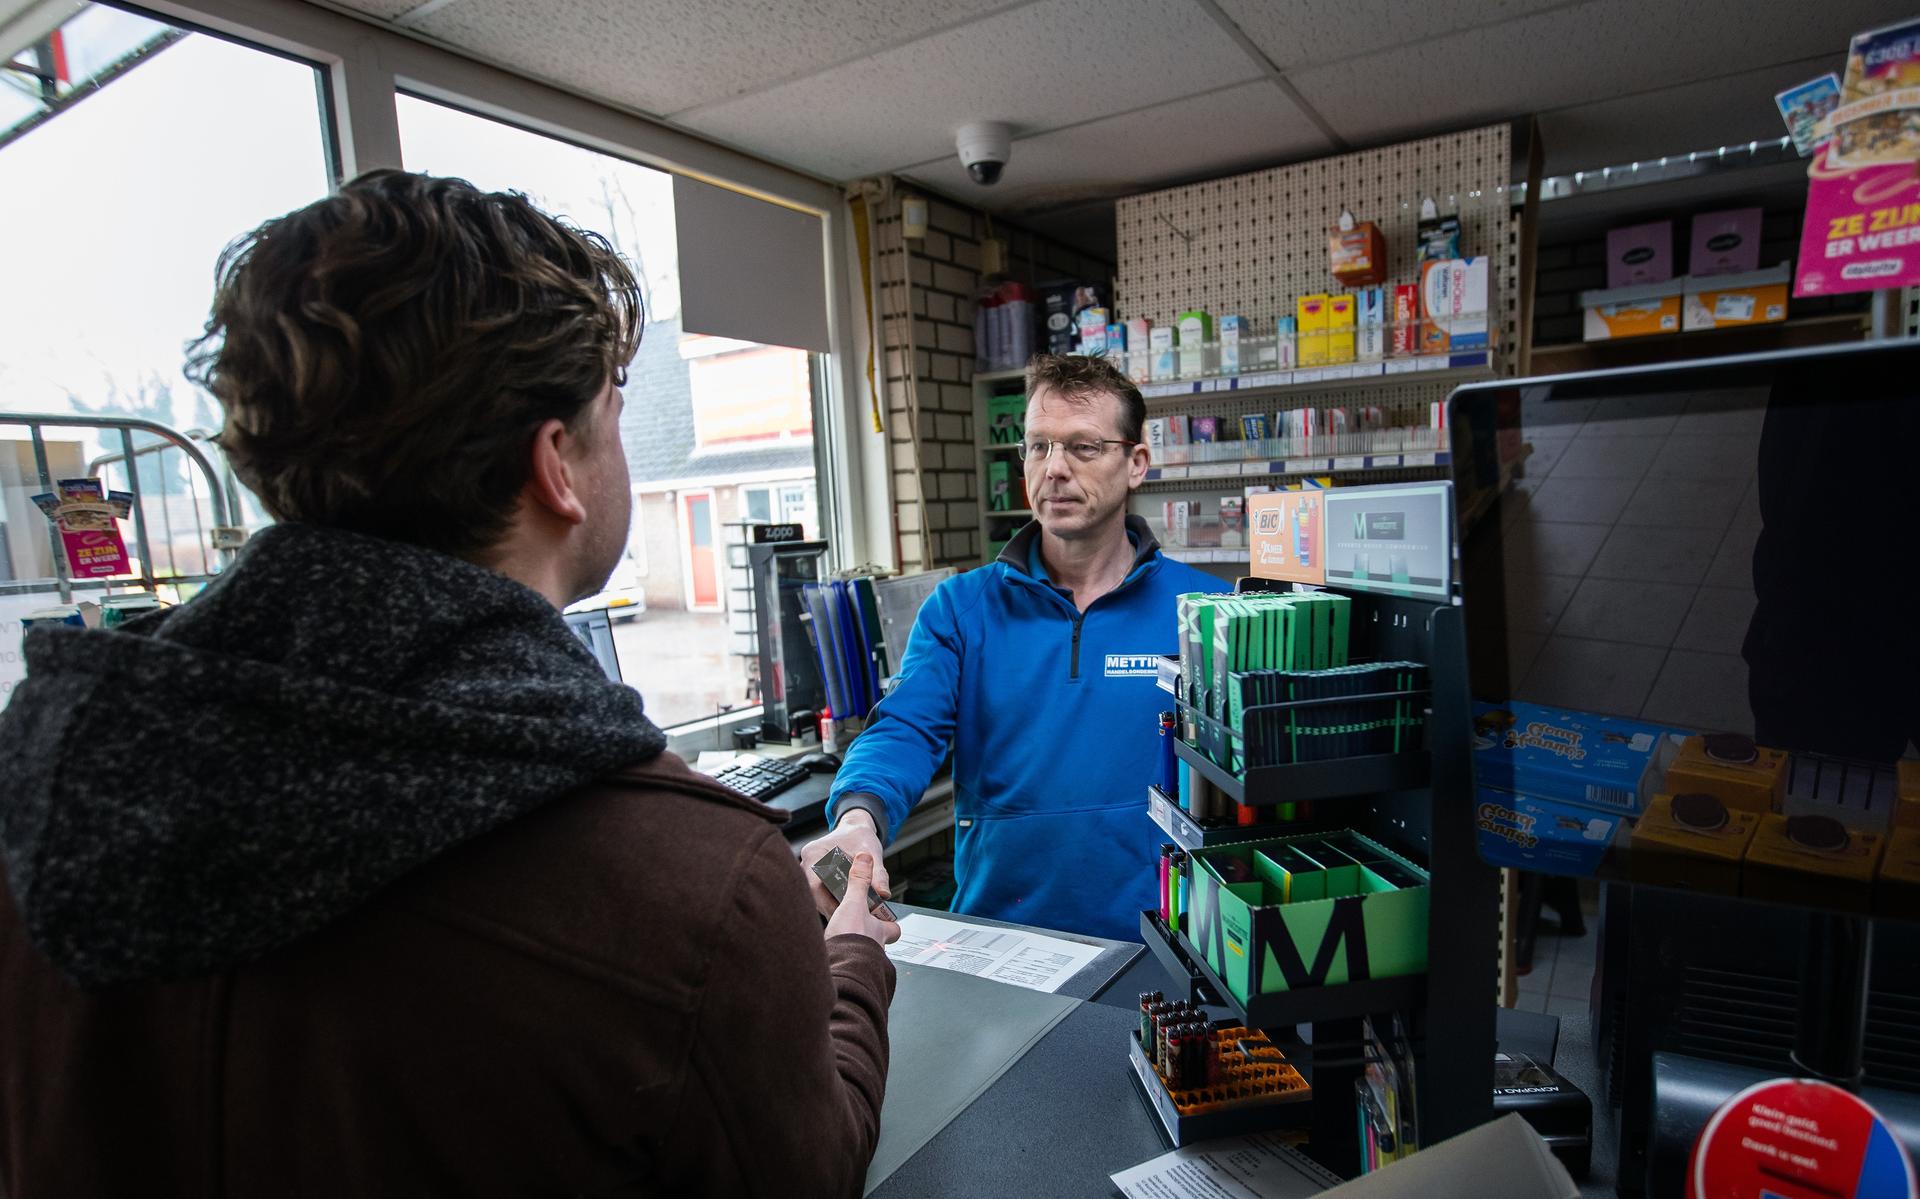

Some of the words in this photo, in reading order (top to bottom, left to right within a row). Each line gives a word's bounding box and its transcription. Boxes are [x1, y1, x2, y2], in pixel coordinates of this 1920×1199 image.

[1827, 213, 1864, 240] ZE
[1824, 238, 1854, 258] ER
[1181, 654, 1190, 721] MASCOTE
[1194, 664, 1206, 732] MASCOTE
[1213, 671, 1221, 741] MASCOTE
[1752, 1103, 1785, 1120] Klein
[1741, 1136, 1777, 1157] Dank
[1778, 1149, 1789, 1160] u
